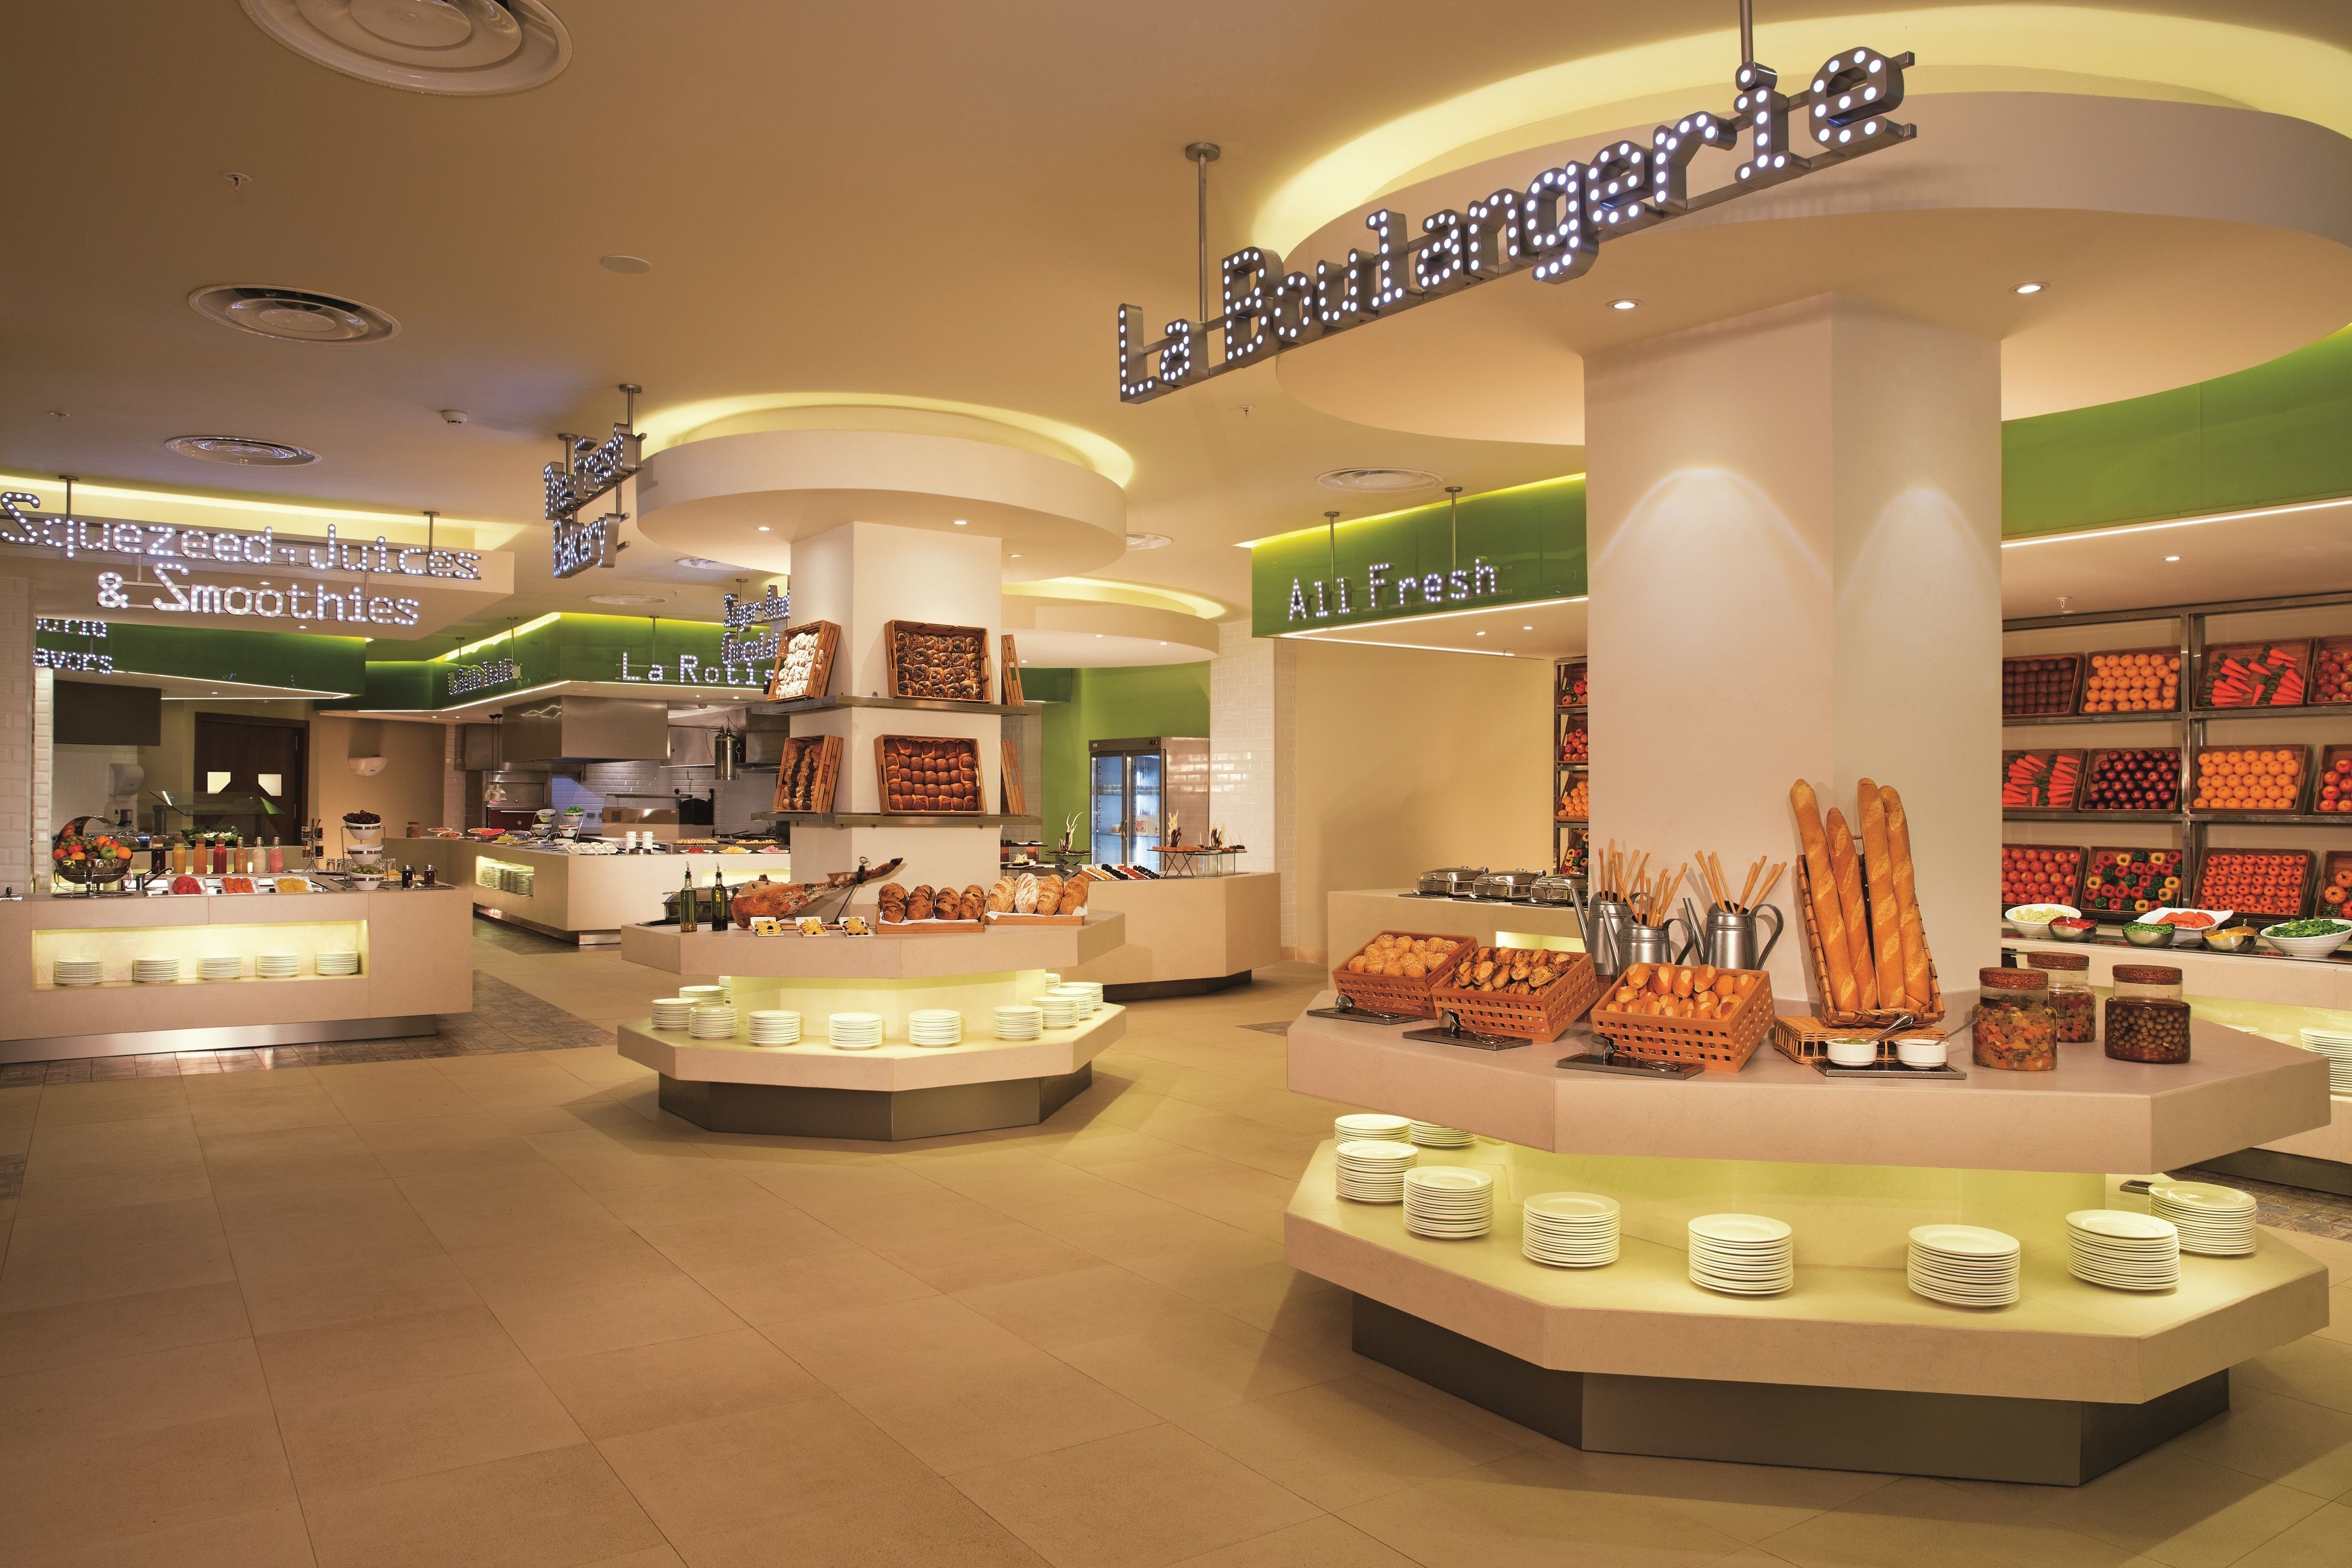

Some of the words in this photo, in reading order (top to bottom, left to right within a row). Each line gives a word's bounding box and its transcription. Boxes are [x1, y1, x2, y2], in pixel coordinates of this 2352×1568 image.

[1118, 303, 1204, 404] La
[1222, 47, 1904, 369] Boulangerie
[544, 462, 575, 520] The
[575, 422, 636, 500] Fresh
[309, 524, 478, 579] Juices
[553, 513, 620, 578] Bakery
[97, 571, 129, 608] &
[153, 562, 420, 625] Smoothies
[1288, 576, 1353, 621] All
[1369, 556, 1497, 609] Fresh
[622, 651, 663, 682] La
